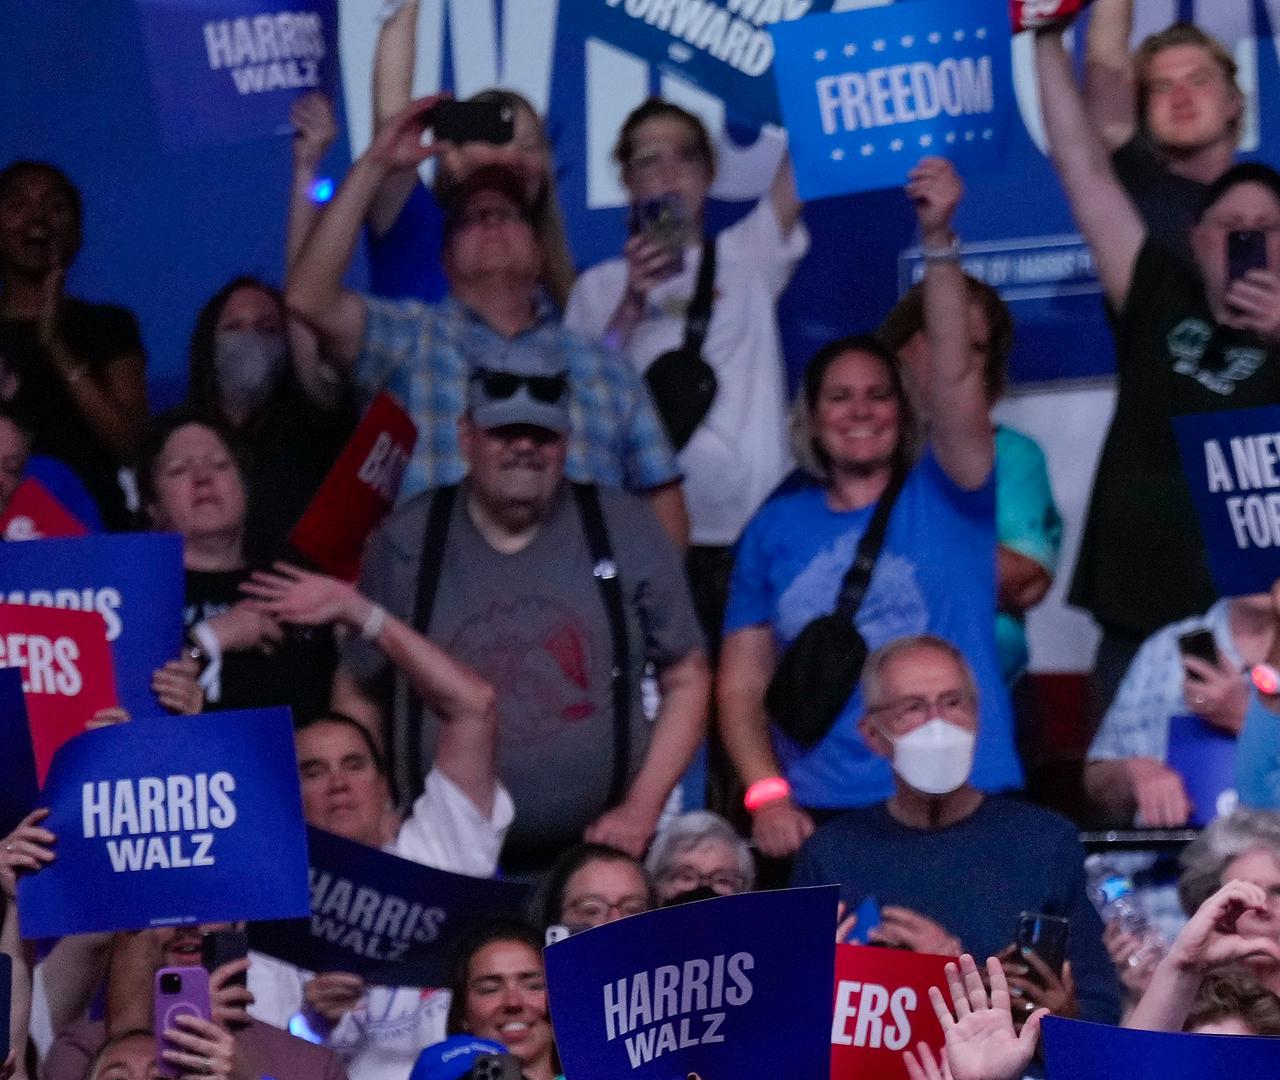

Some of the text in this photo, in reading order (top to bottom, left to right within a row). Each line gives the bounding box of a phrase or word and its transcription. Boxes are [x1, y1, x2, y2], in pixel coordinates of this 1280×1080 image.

[205, 12, 325, 71] HARRIS
[230, 49, 321, 96] WALZ
[816, 56, 995, 137] FREEDOM
[1204, 440, 1233, 495] A
[81, 771, 236, 838] HARRIS
[106, 833, 214, 873] WALZ
[308, 867, 447, 944] HARRIS
[309, 919, 411, 962] WALZ
[602, 951, 755, 1041] HARRIS
[624, 1012, 726, 1069] WALZ
